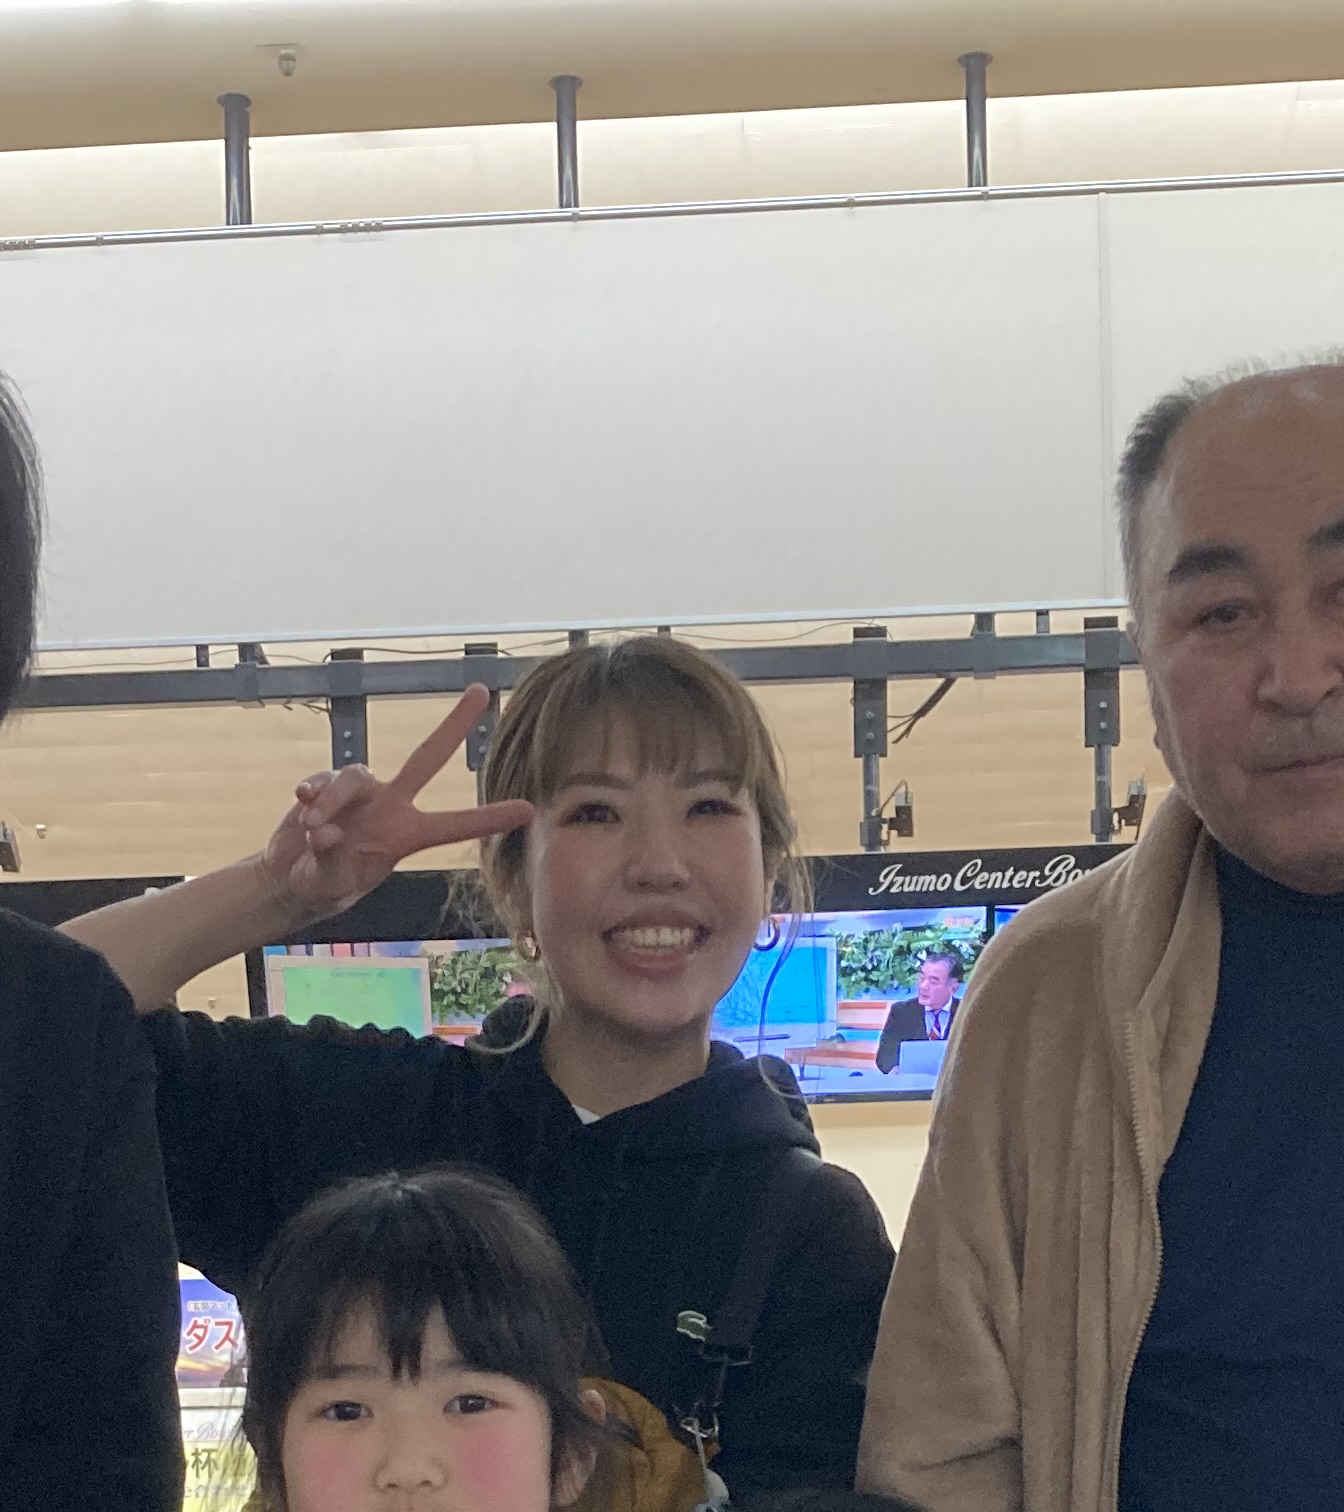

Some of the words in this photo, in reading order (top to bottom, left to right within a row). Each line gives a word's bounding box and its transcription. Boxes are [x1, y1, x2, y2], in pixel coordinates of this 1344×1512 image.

[868, 863, 952, 896] Izumo
[953, 858, 1039, 891] Center
[1035, 854, 1094, 888] Bo
[190, 1447, 219, 1479] 杯
